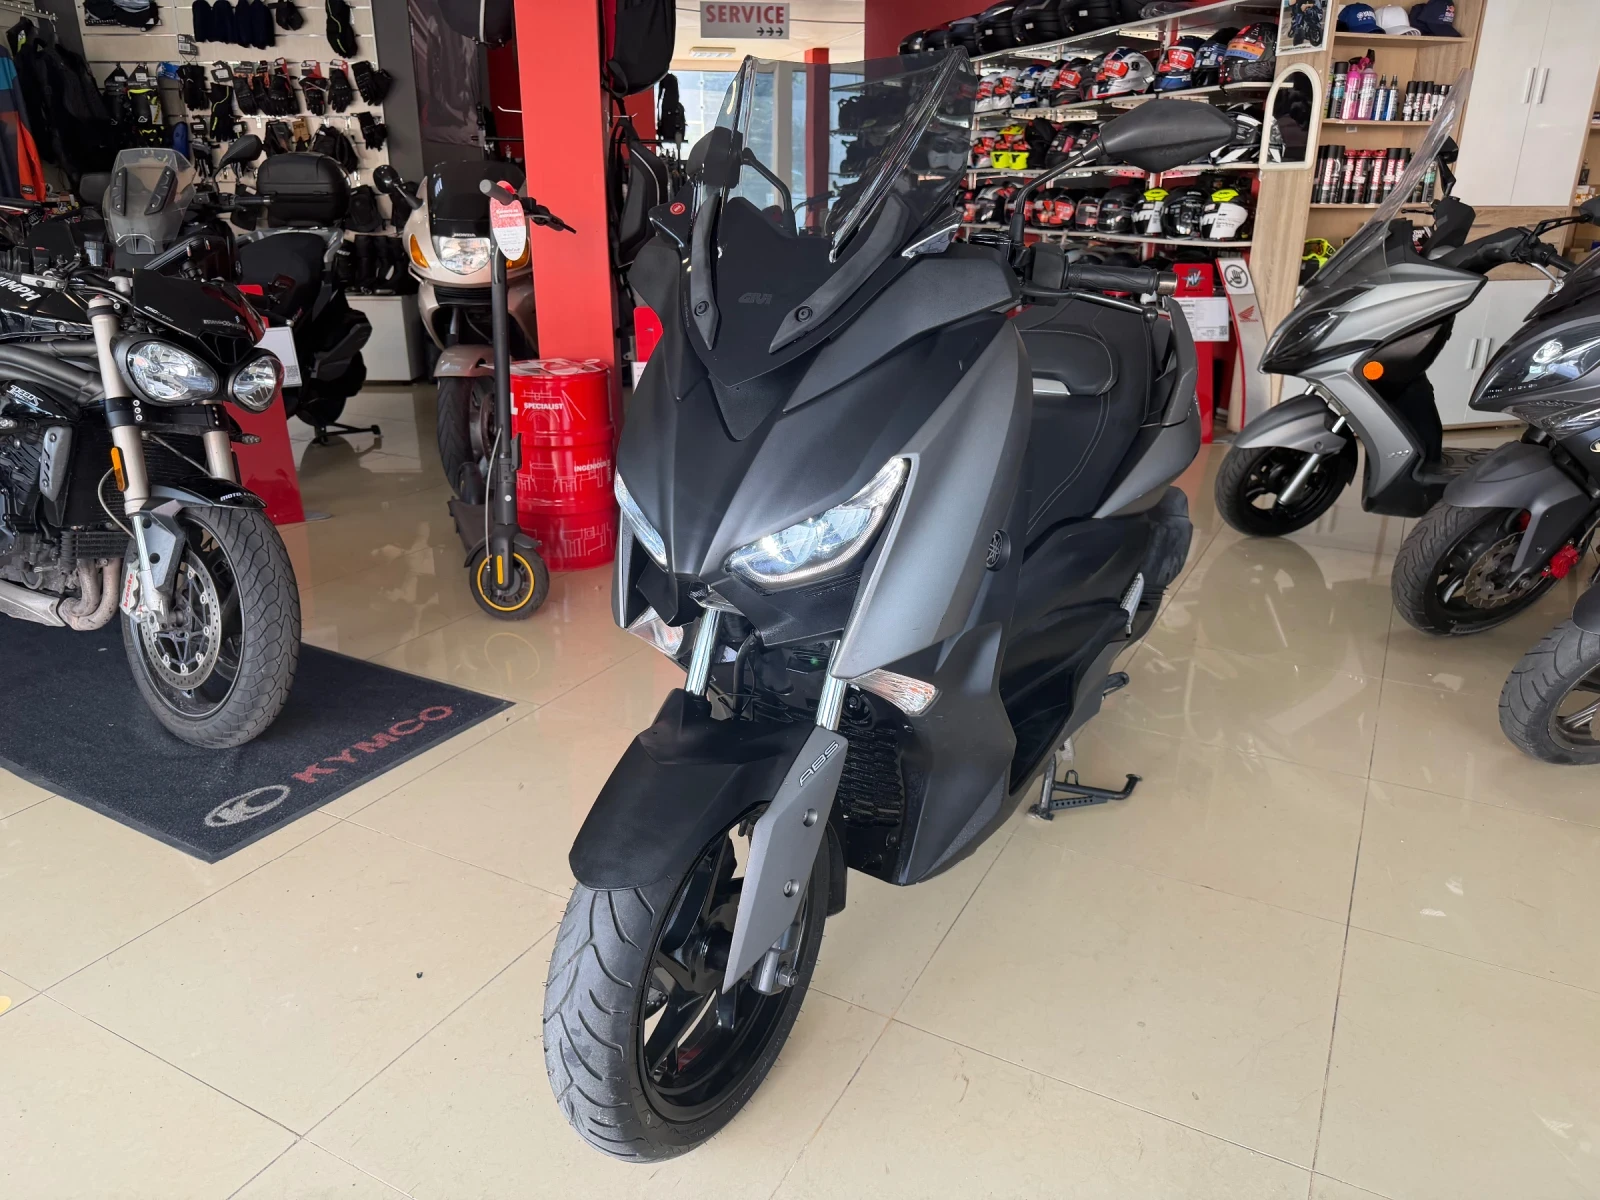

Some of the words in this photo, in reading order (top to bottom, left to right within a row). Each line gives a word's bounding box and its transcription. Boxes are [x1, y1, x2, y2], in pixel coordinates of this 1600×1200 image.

[705, 4, 785, 24] SERVICE
[1324, 159, 1333, 183] MOTUL
[1373, 159, 1382, 183] MOTUL
[738, 292, 773, 304] GIVI
[523, 402, 564, 410] SPECIALIST
[574, 460, 607, 473] INGENIOUS
[123, 573, 133, 608] brembo
[292, 705, 453, 784] KYMCO
[799, 740, 839, 787] ABS
